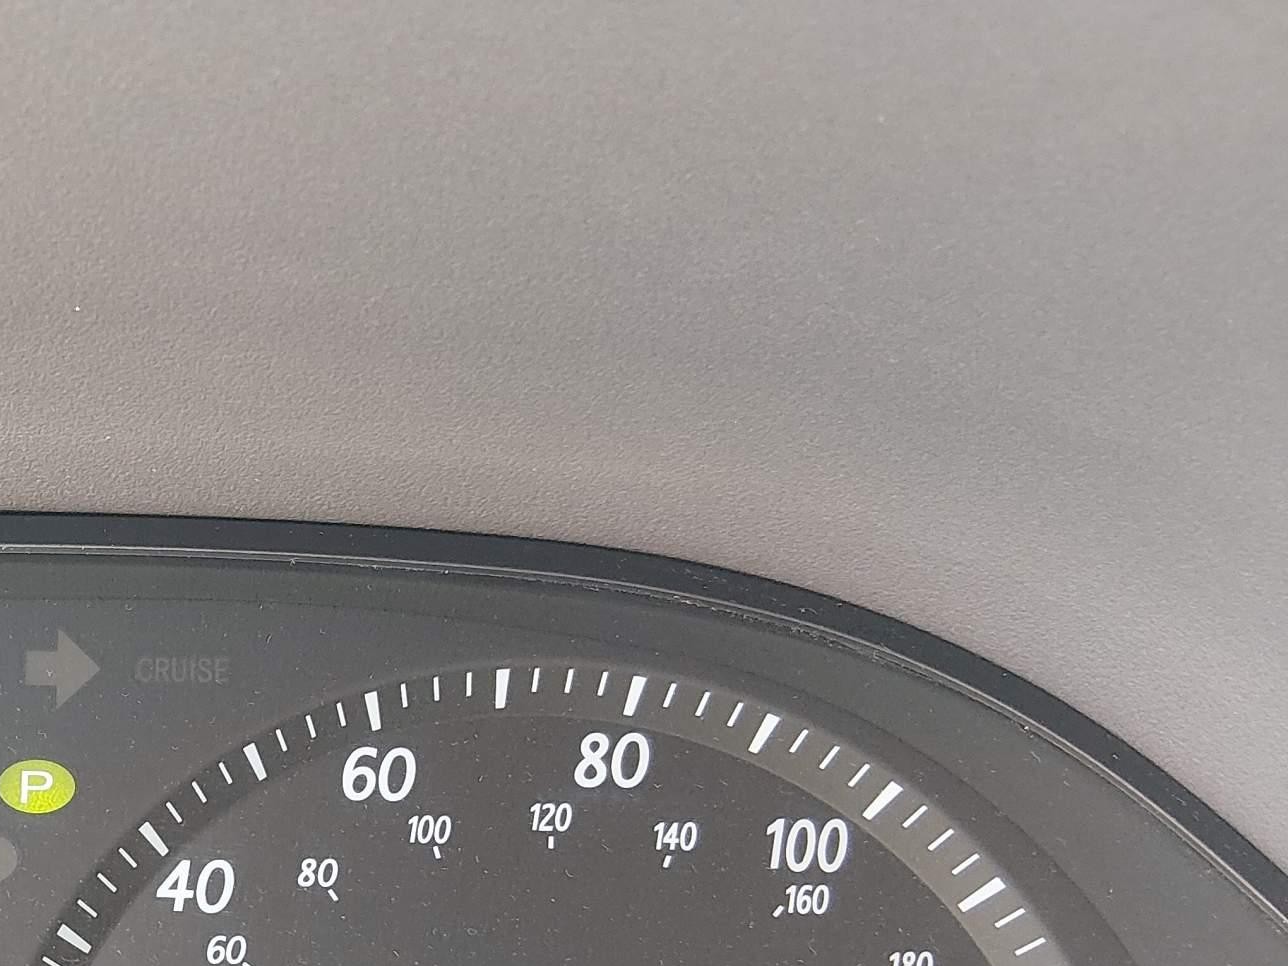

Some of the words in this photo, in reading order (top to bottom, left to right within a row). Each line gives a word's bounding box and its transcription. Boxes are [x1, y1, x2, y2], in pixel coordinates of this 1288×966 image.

[135, 656, 230, 684] CRUISE
[341, 747, 416, 802] 60
[574, 732, 650, 788] 80
[19, 770, 54, 804] P
[408, 815, 451, 845] 100
[530, 803, 572, 833] 120
[653, 821, 697, 853] 140
[765, 818, 849, 873] 100
[156, 859, 235, 914] 40
[297, 858, 339, 888] 80
[785, 885, 830, 915] 160
[205, 935, 247, 966] 60
